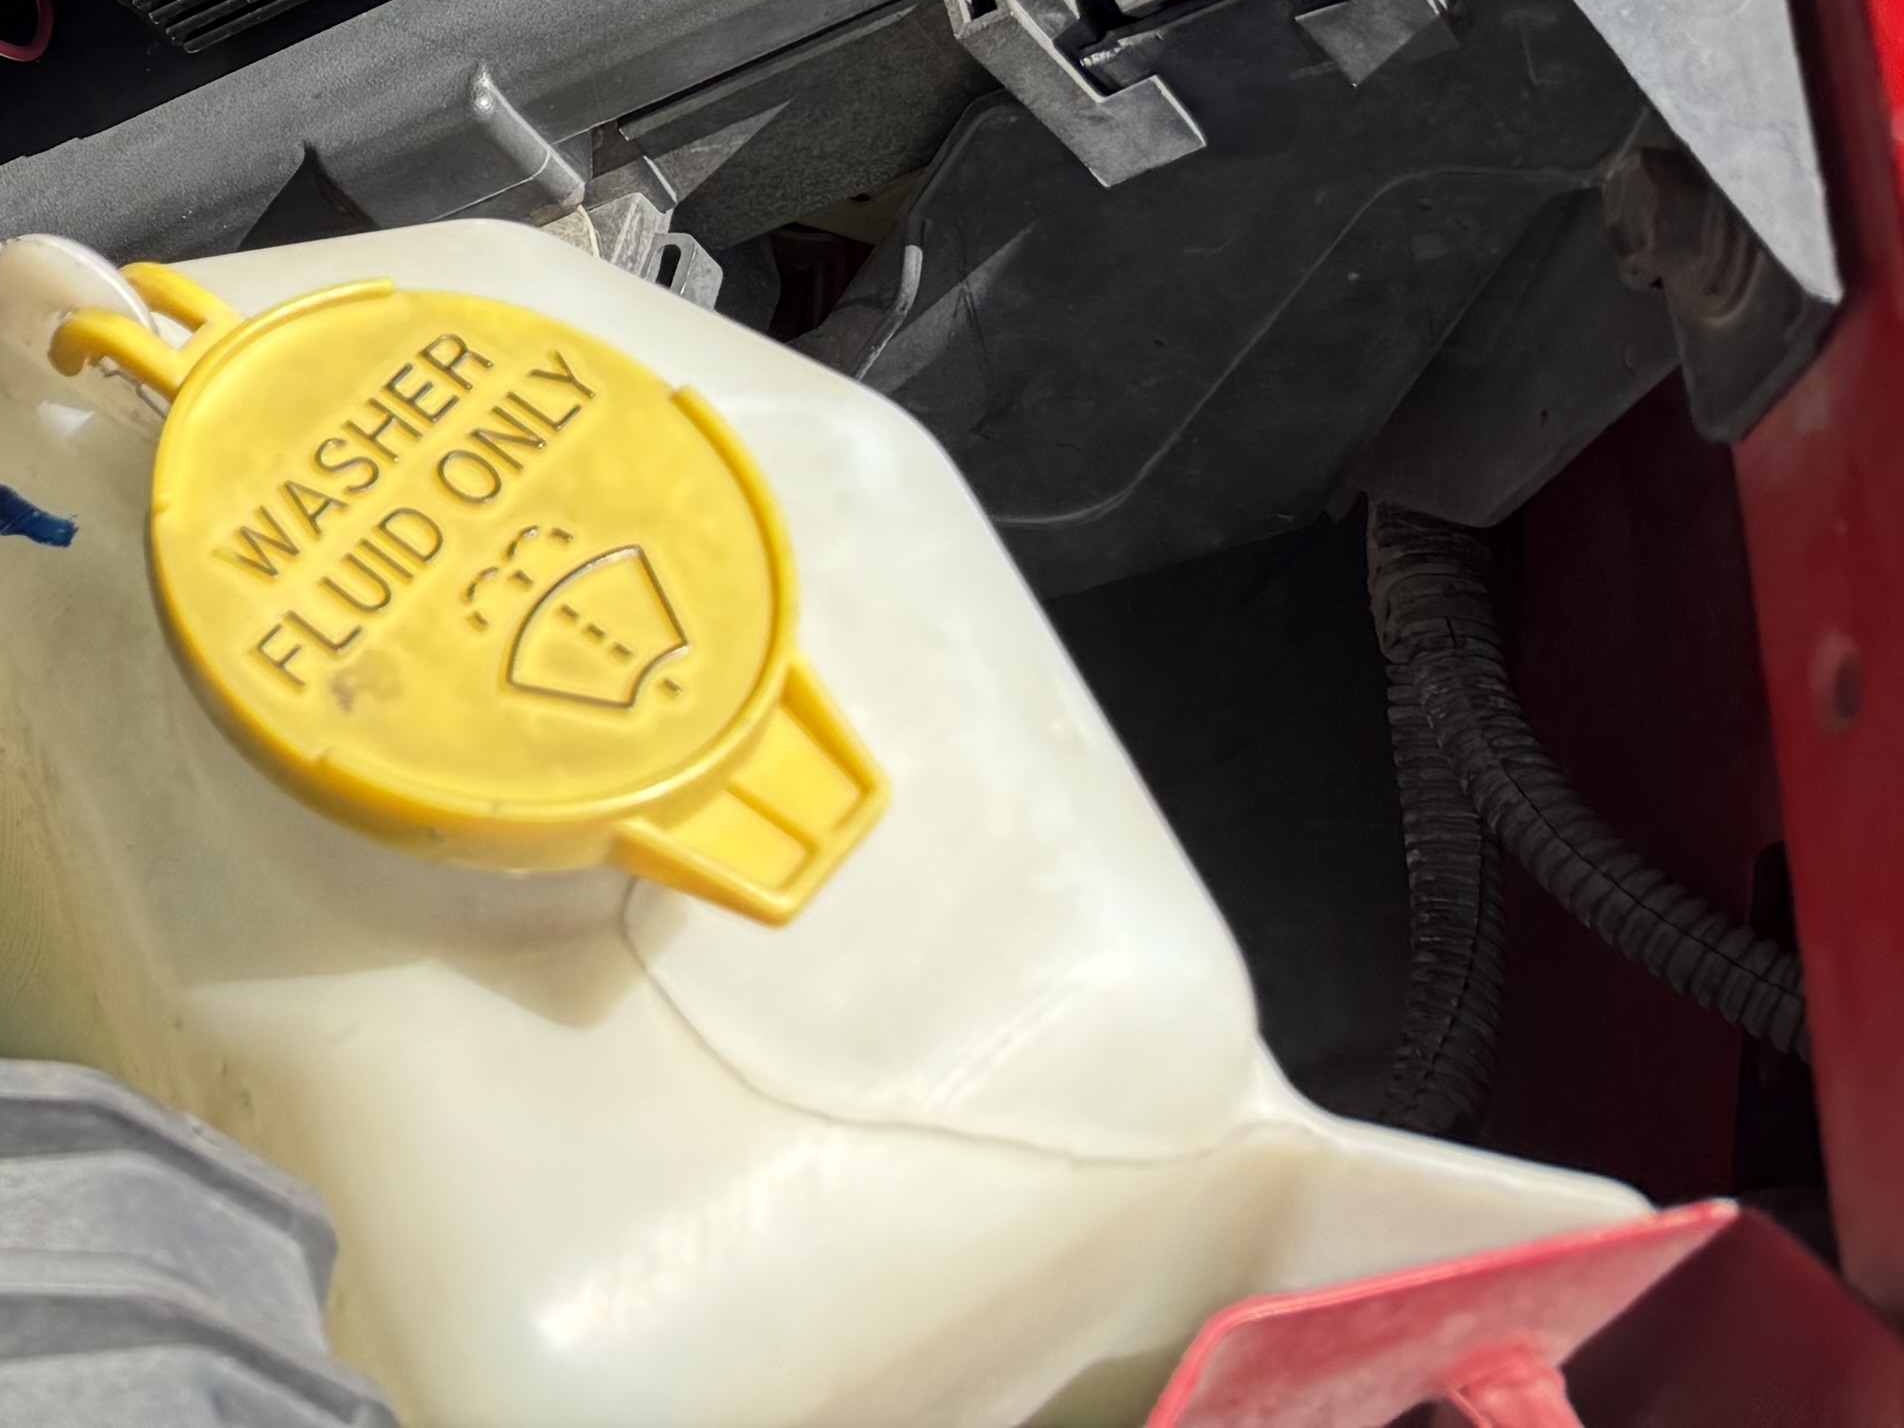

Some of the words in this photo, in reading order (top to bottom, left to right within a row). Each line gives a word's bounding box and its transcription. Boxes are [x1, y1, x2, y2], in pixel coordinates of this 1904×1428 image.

[211, 330, 497, 584] WASHER
[253, 504, 445, 694] FLUID
[436, 346, 600, 506] ONLY
